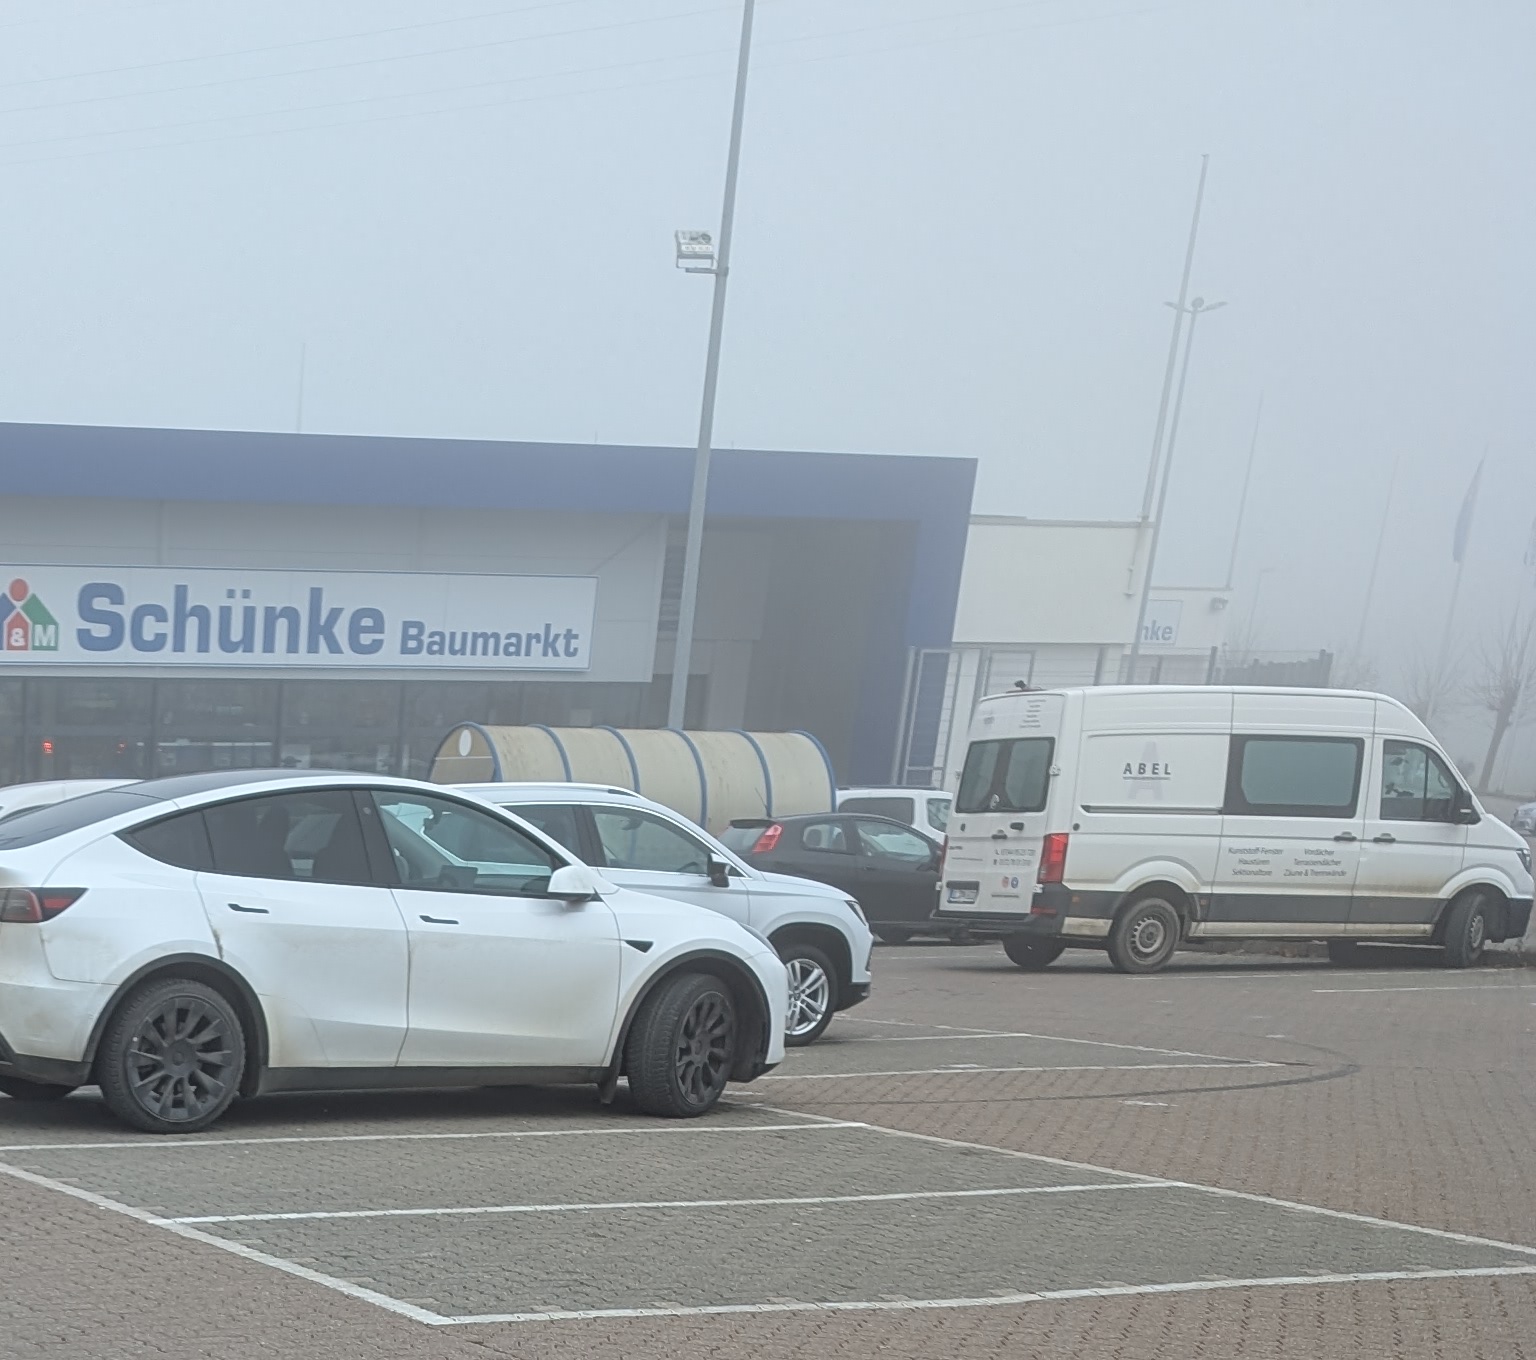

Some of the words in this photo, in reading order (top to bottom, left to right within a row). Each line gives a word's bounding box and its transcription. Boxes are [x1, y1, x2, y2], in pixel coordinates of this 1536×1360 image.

[76, 582, 386, 656] Schünke
[400, 620, 579, 658] Baumarkt
[1123, 762, 1172, 775] ABEL
